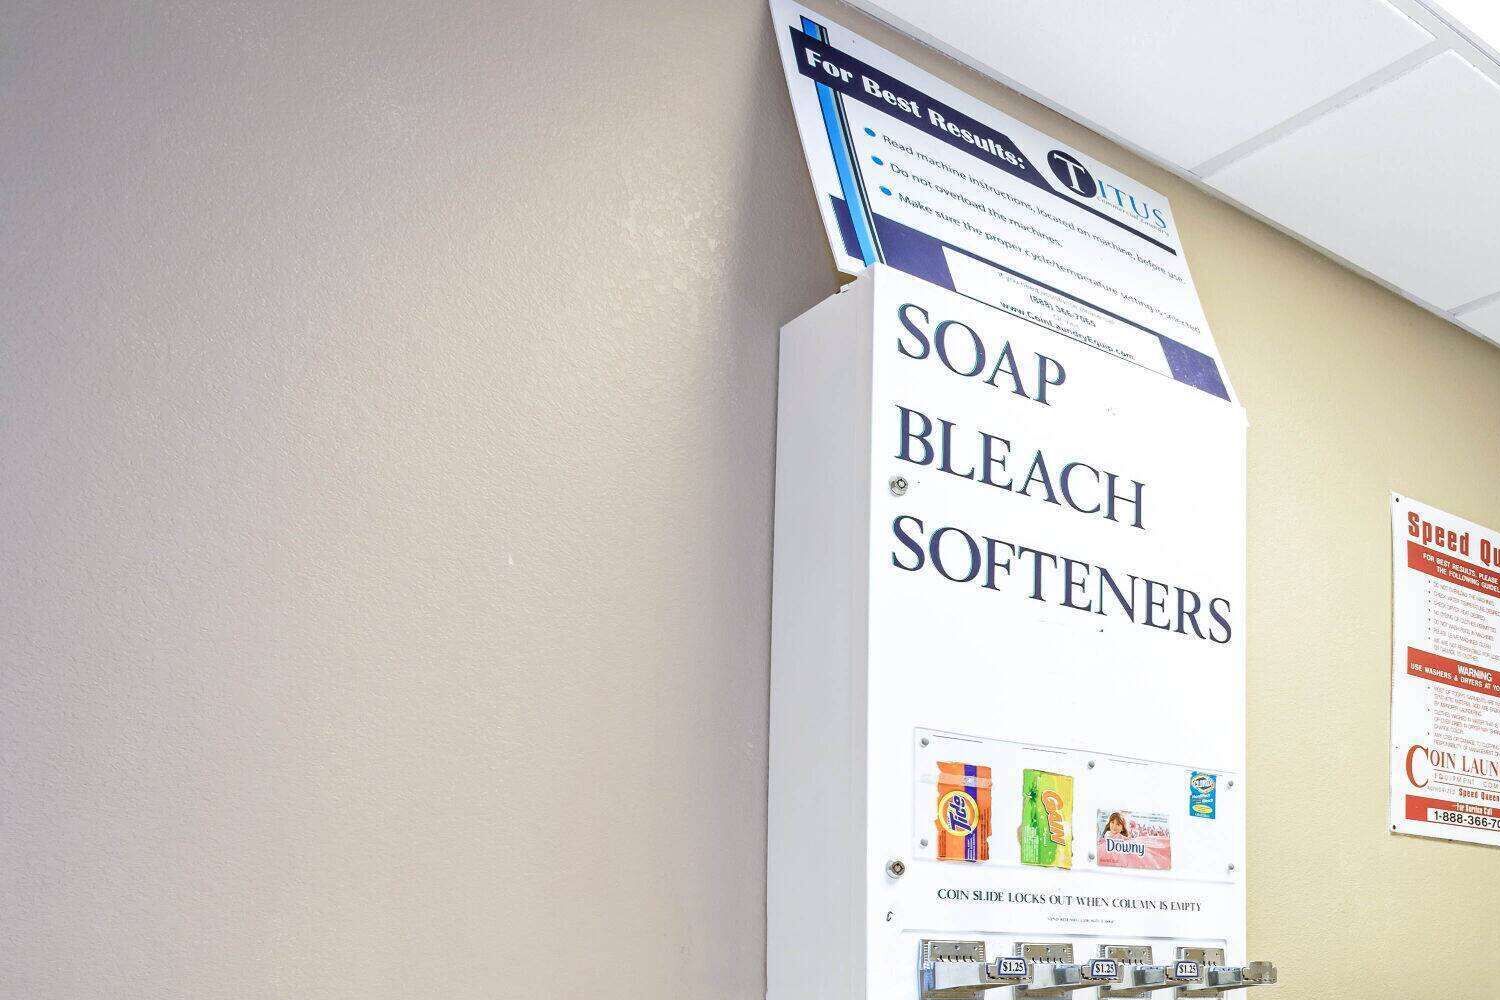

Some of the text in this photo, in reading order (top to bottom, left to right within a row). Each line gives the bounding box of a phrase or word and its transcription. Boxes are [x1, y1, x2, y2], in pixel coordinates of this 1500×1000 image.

[804, 47, 1027, 170] For Best Results:
[882, 134, 914, 155] Read
[916, 152, 967, 180] machine
[1036, 206, 1075, 230] located
[1077, 226, 1091, 237] on
[1137, 254, 1166, 274] before
[890, 162, 909, 178] Do
[911, 175, 934, 189] not
[935, 184, 986, 212] overload
[988, 208, 1007, 222] the
[1051, 152, 1169, 230] TITUS
[898, 192, 933, 214] Make
[935, 210, 961, 226] sure
[962, 220, 983, 235] the
[985, 232, 1022, 253] proper
[896, 302, 1067, 406] SOAP
[894, 404, 1146, 530] BLEACH
[1407, 511, 1469, 557] Speed
[891, 514, 1232, 644] SOFTENERS
[1423, 552, 1435, 563] FOR
[1435, 556, 1450, 568] BEST
[1479, 570, 1499, 584] PLEASE
[1436, 565, 1447, 575] THE
[1449, 569, 1480, 586] FOLLOWING
[1410, 662, 1423, 672] USE
[1424, 666, 1452, 680] WASHERS
[1460, 676, 1483, 688] DRYERS
[1484, 681, 1491, 690] AT
[1457, 664, 1493, 682] WARNING
[1406, 744, 1456, 789] COIN
[1433, 772, 1475, 784] EQUIPMENT
[1458, 788, 1479, 799] Speed
[1480, 792, 1500, 802] Queen
[949, 795, 972, 832] Tide
[1106, 838, 1145, 857] Downy
[937, 888, 1202, 912] COIN SLIDE LOCKS OUT WHEN COLUMN IS EMPTY
[1002, 961, 1024, 972] $1.25
[1095, 963, 1114, 974] $1.25
[1178, 963, 1196, 974] $1.25
